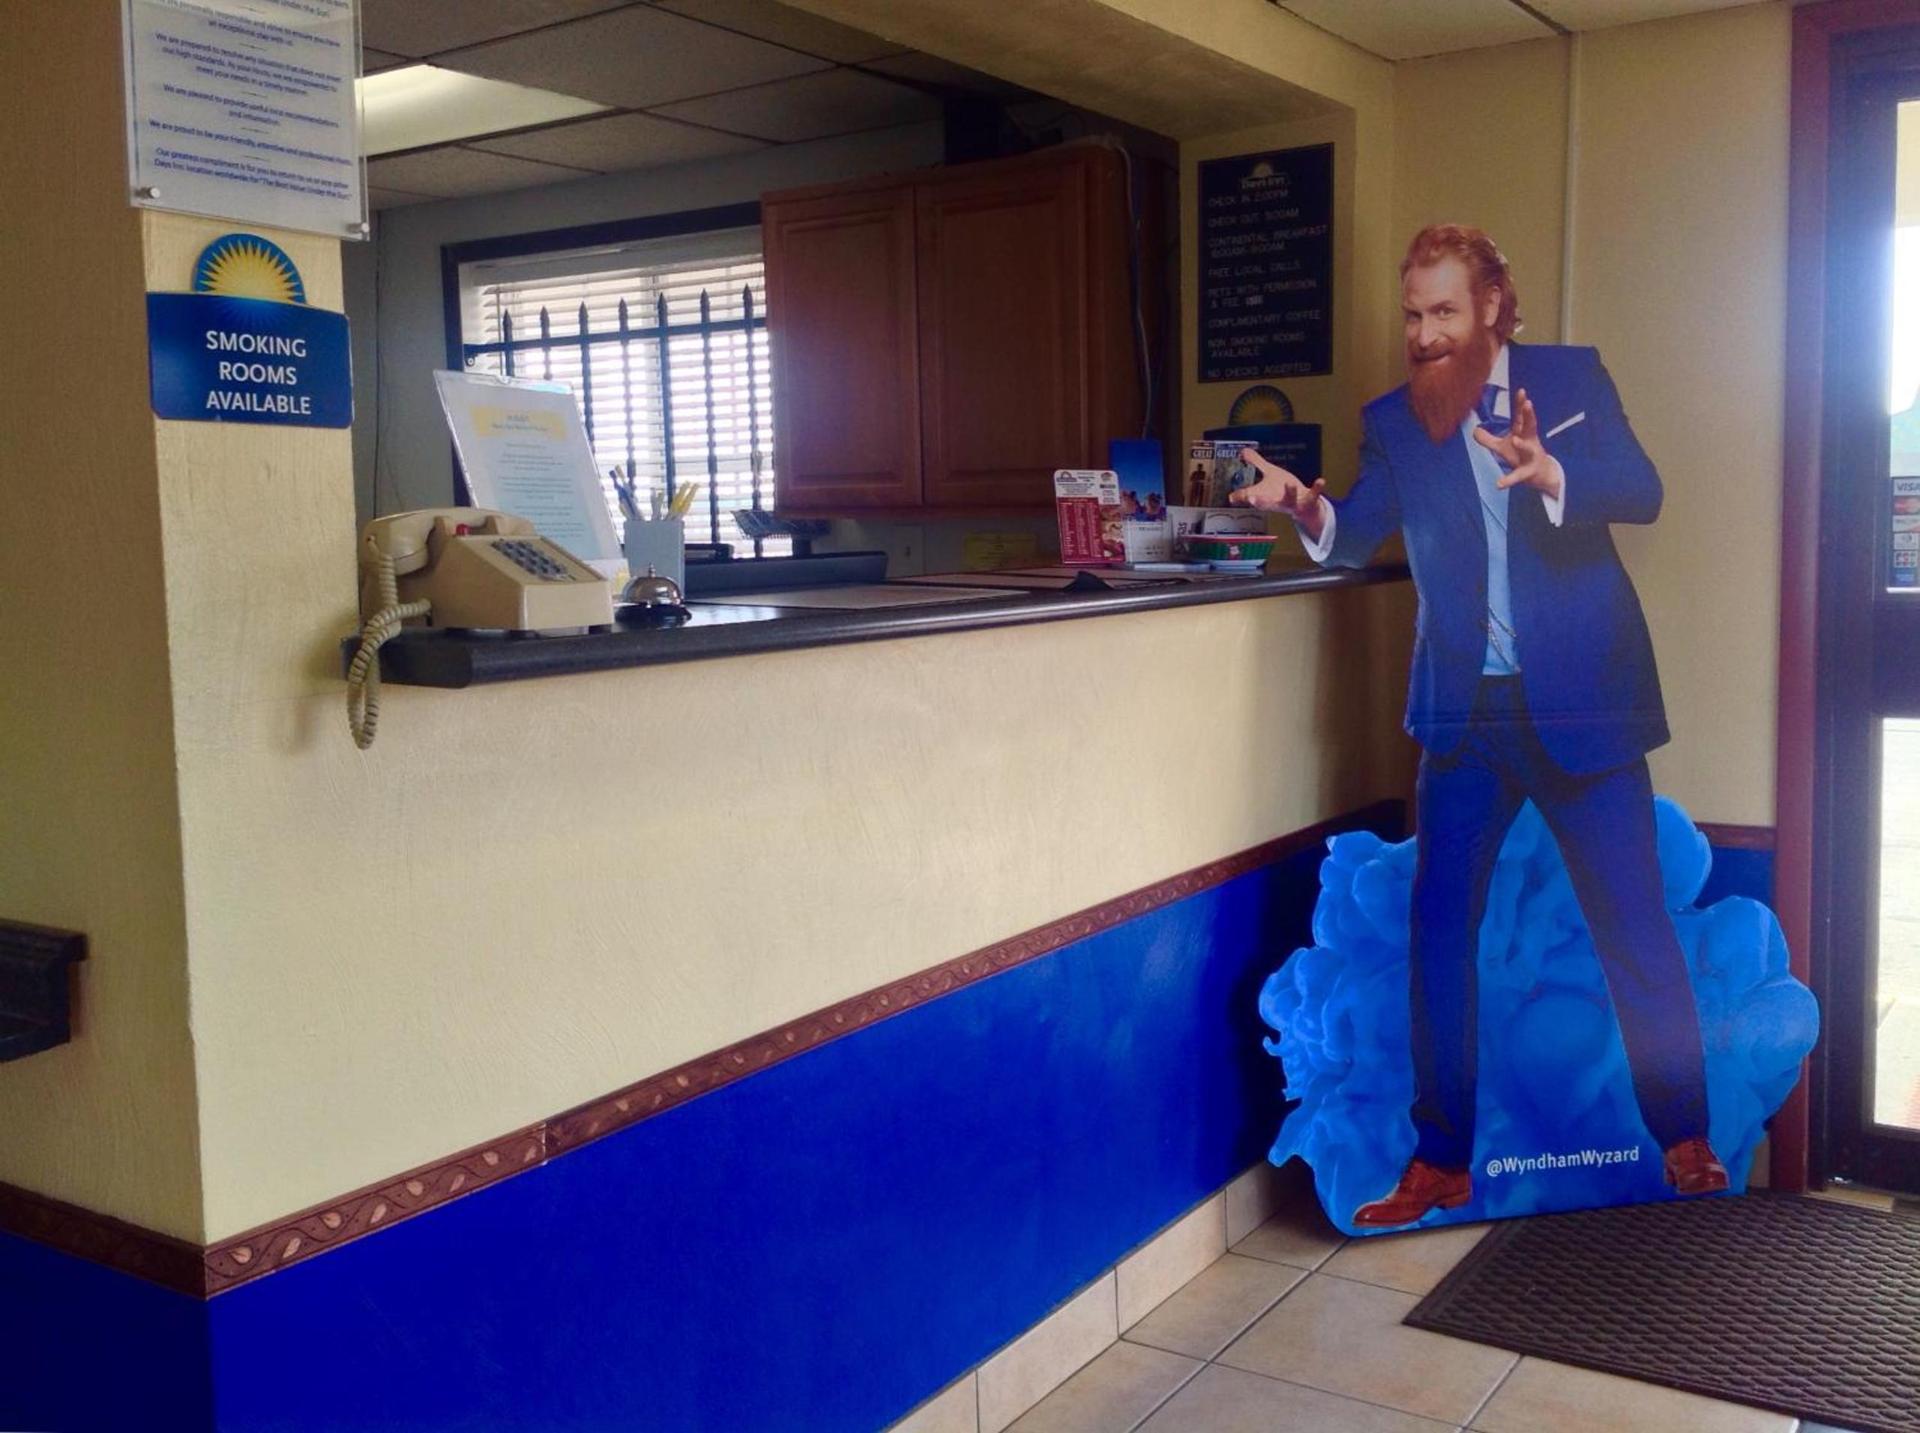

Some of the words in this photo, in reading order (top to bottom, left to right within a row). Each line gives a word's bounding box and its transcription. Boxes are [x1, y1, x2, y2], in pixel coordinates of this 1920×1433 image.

[206, 330, 307, 357] SMOKING
[219, 362, 297, 385] ROOMS
[206, 390, 312, 415] AVAILABLE
[1486, 1146, 1640, 1177] @WyndhamWyzard
